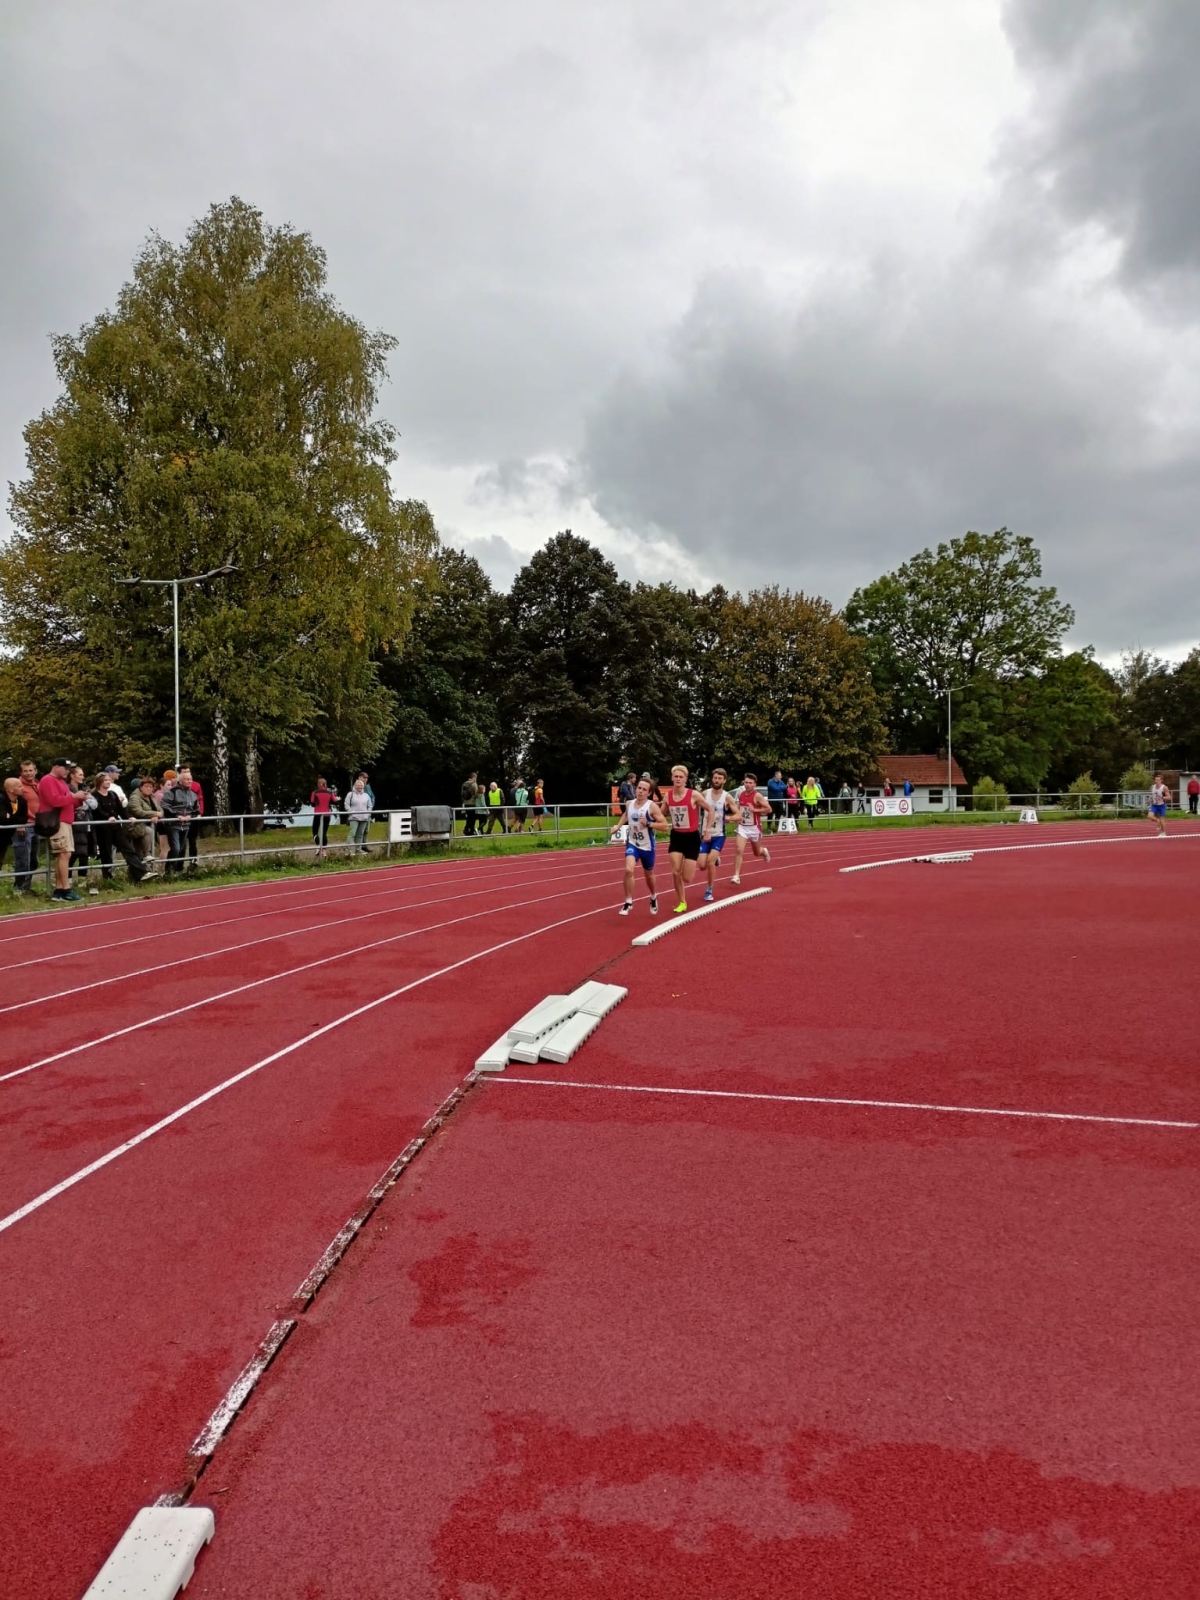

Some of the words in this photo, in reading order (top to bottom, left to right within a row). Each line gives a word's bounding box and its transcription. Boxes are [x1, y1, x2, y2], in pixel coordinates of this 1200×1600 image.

[674, 813, 684, 822] 37
[781, 821, 787, 830] 5
[615, 828, 621, 839] 6
[633, 831, 644, 840] 48
